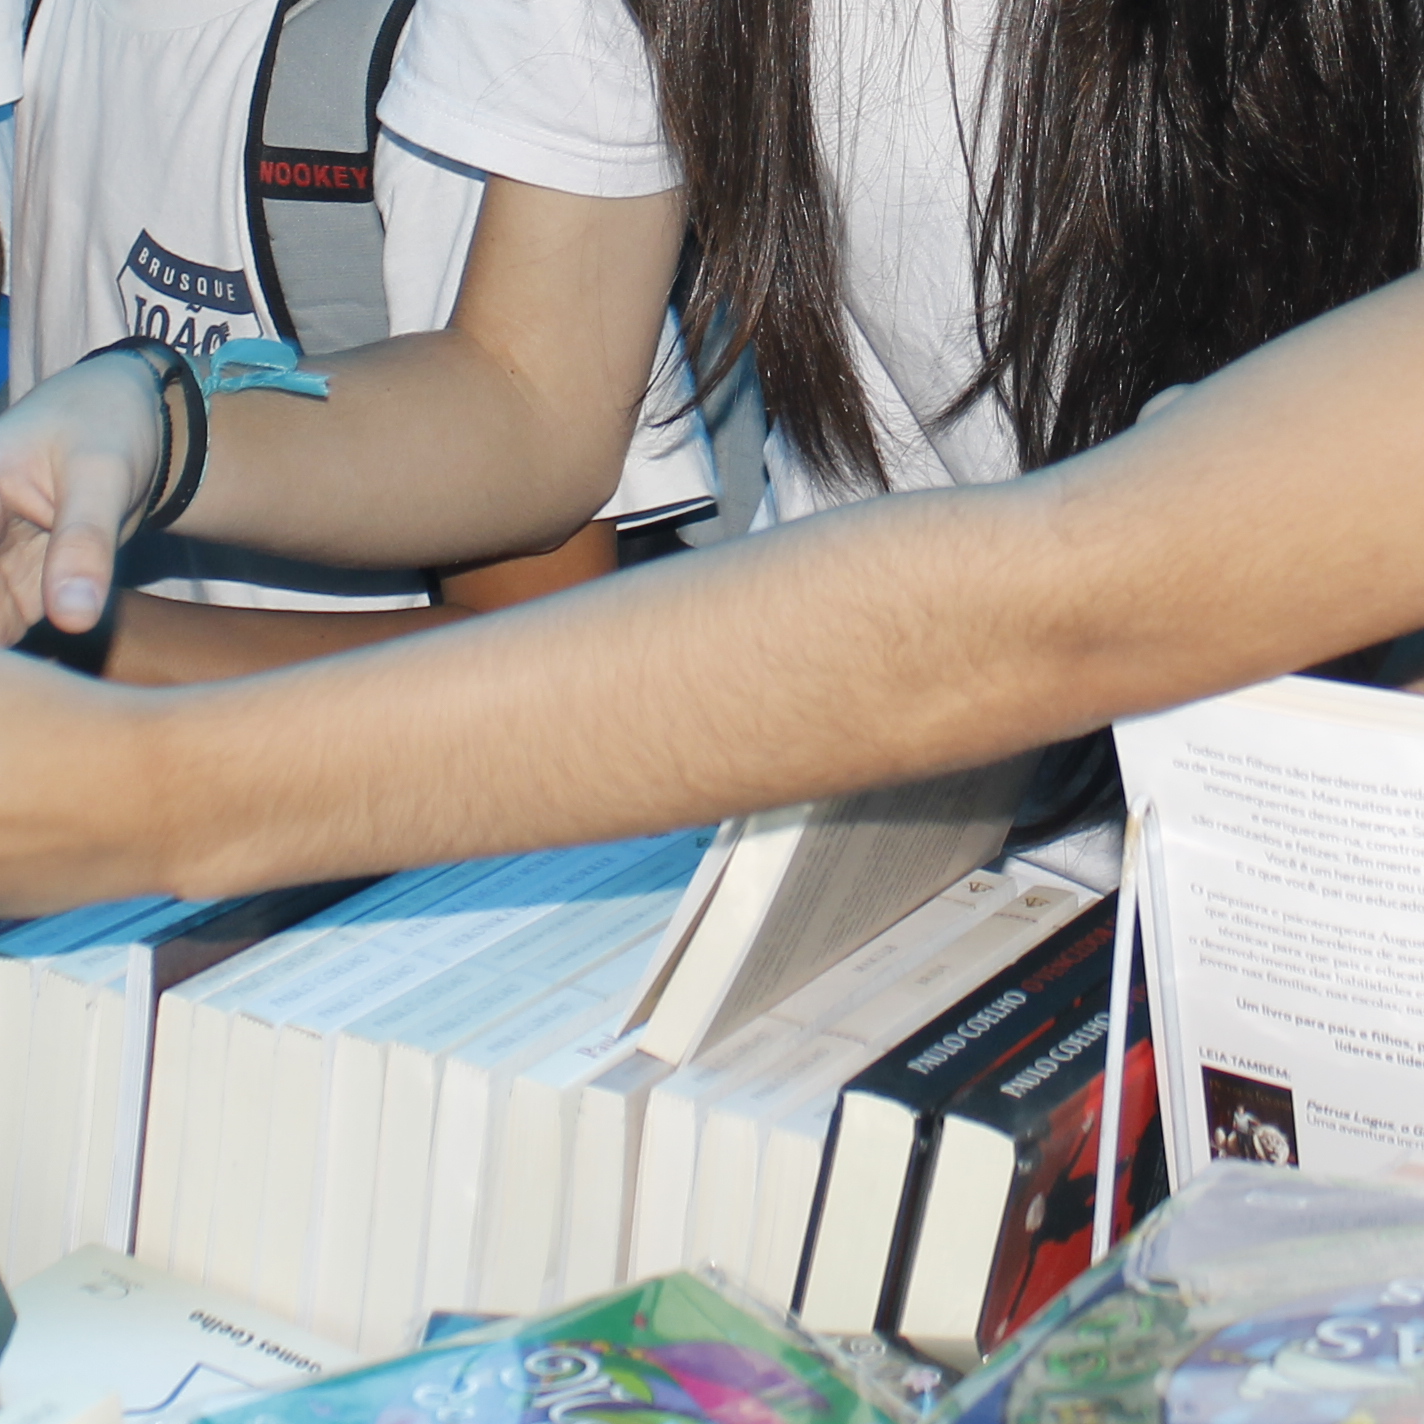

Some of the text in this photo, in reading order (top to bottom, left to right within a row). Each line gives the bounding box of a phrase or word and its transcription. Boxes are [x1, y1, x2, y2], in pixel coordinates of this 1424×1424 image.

[258, 159, 369, 190] NOOKEY
[137, 246, 238, 303] BRUSQUE
[1185, 742, 1225, 761] Todos
[1244, 755, 1282, 775] filhos
[1310, 771, 1378, 795] herdeiros
[1310, 789, 1341, 805] Mas
[906, 1032, 967, 1076] PAULO
[957, 989, 1027, 1039] COELHO
[1234, 996, 1259, 1012] Um
[1260, 1003, 1292, 1022] livro
[1294, 1014, 1325, 1031] para
[1327, 1021, 1356, 1038] pais
[1358, 1030, 1367, 1039] e
[1370, 1029, 1414, 1050] filhos,
[1000, 1011, 1111, 1099] PAULO COELHO
[1196, 1045, 1228, 1064] LEIA
[1333, 1039, 1382, 1060] líderes
[1384, 1052, 1393, 1062] e
[1303, 1096, 1352, 1121] Petrus
[189, 1308, 254, 1347] Coelho
